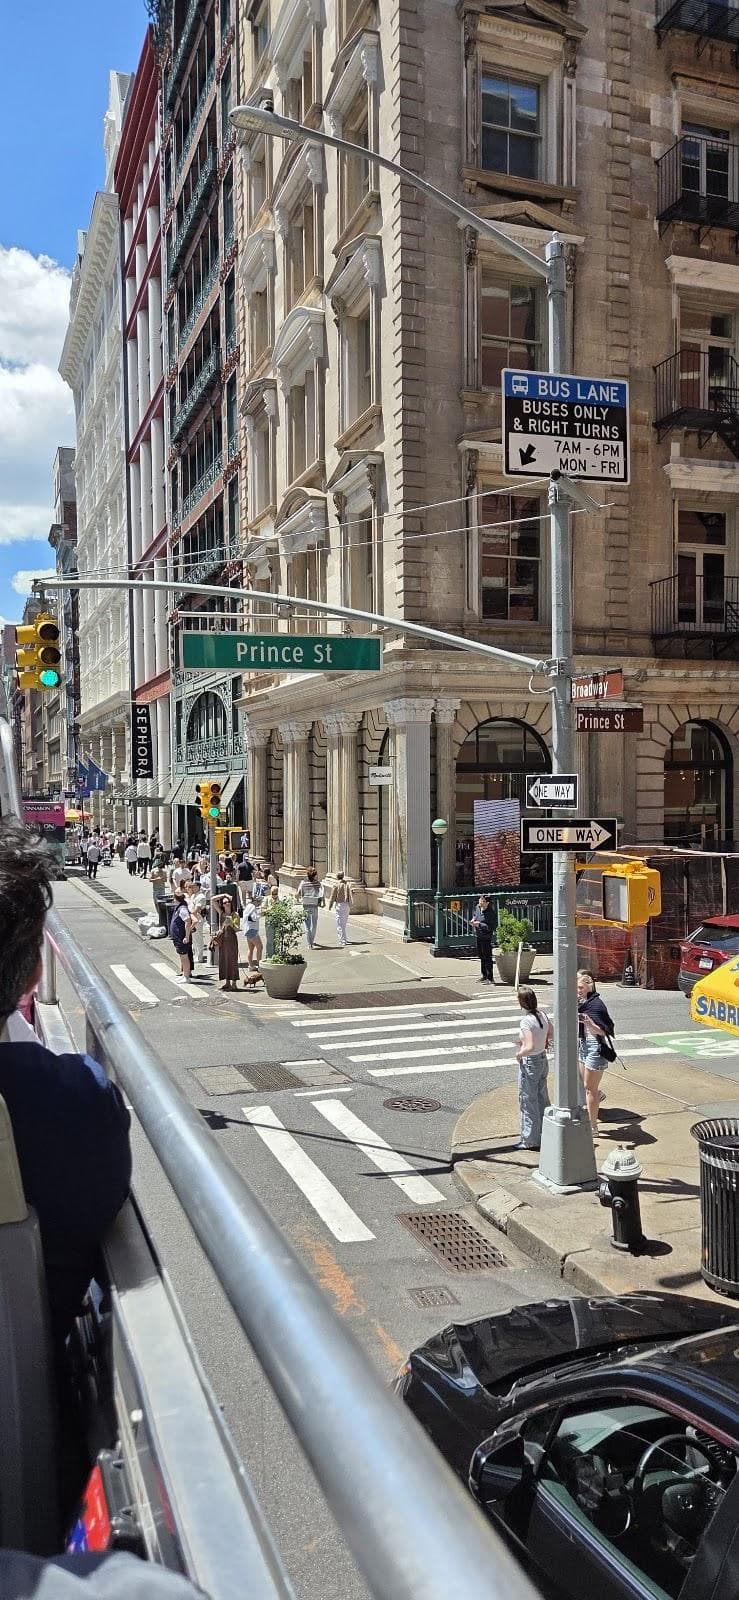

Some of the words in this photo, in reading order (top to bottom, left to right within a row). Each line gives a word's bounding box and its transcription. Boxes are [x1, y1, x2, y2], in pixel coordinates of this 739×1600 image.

[538, 379, 570, 398] BUS
[577, 383, 620, 403] LANE
[522, 400, 569, 417] BUSES
[573, 405, 609, 420] ONLY
[513, 417, 523, 431] &
[528, 418, 569, 435] RIGHT
[573, 422, 620, 439] TURNS
[554, 440, 581, 454] 7AM
[593, 443, 620, 457] 6PM
[559, 458, 587, 472] MON
[600, 460, 620, 474] FRI
[236, 641, 304, 663] Prince
[313, 643, 333, 664] St
[571, 680, 609, 699] Broadway
[577, 713, 610, 729] Prince
[614, 713, 625, 730] St
[136, 707, 150, 776] SEPHORA
[534, 785, 548, 798] ONE
[554, 785, 571, 799] WAY
[536, 829, 563, 842] ONE
[575, 829, 602, 842] WAY
[696, 995, 739, 1027] SABR
